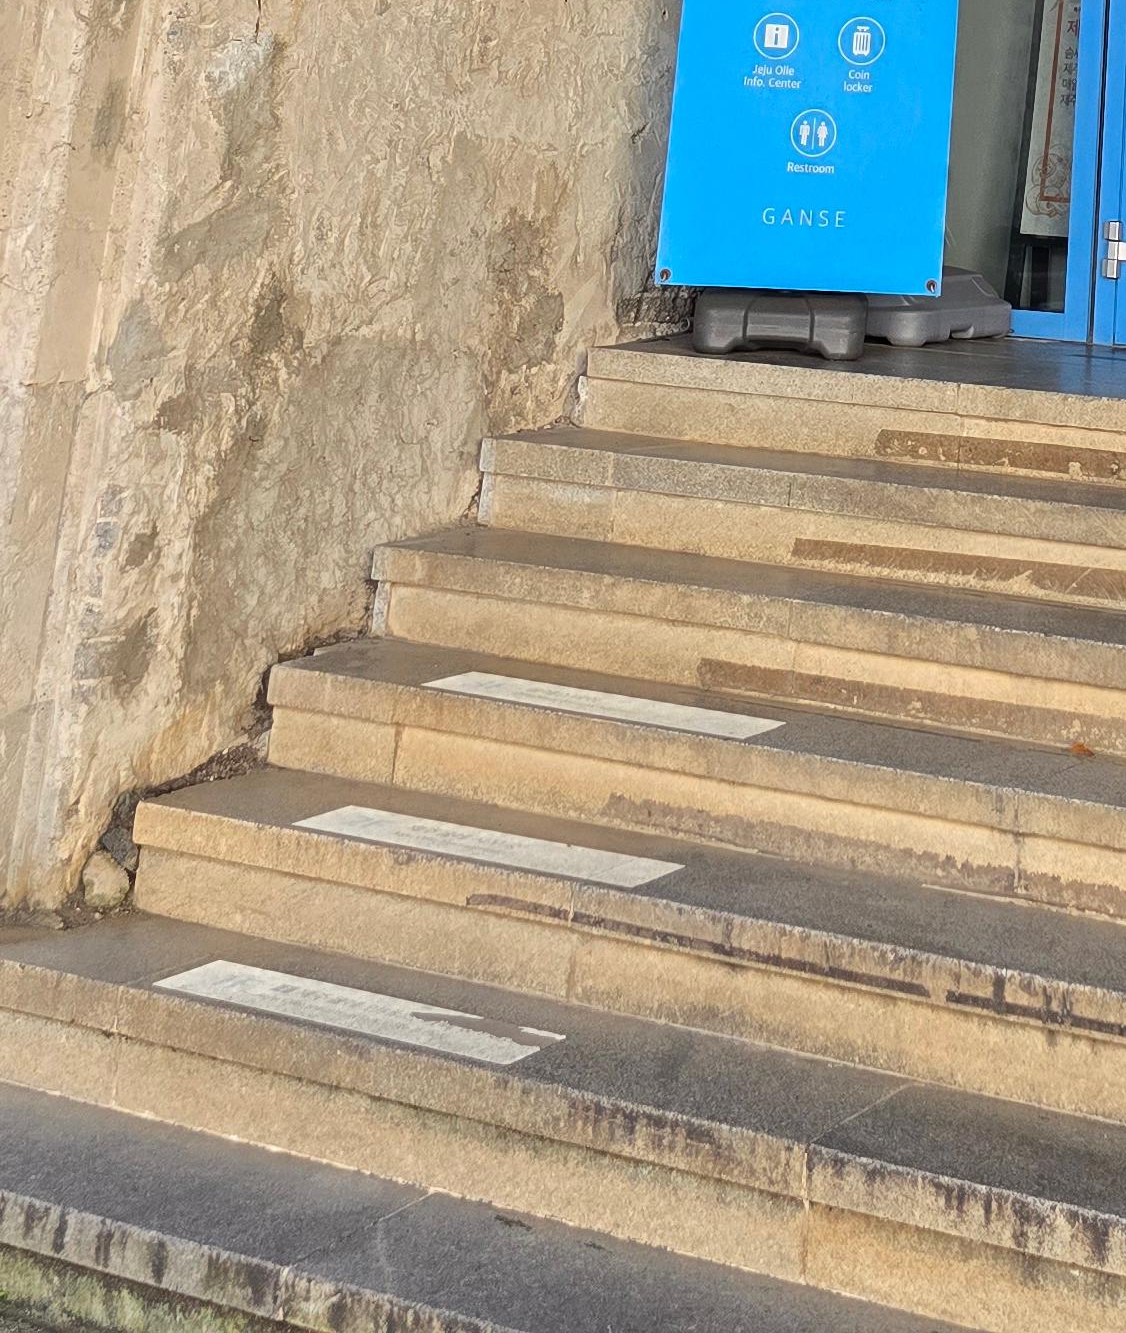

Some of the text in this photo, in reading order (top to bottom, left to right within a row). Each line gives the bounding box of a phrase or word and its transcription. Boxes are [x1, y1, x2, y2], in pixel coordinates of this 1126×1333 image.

[752, 65, 795, 77] Jeju Olle
[848, 69, 870, 81] Coin
[743, 77, 802, 89] Info. Center
[843, 82, 873, 93] locker
[787, 161, 835, 174] Restroom
[762, 207, 846, 228] GANSE
